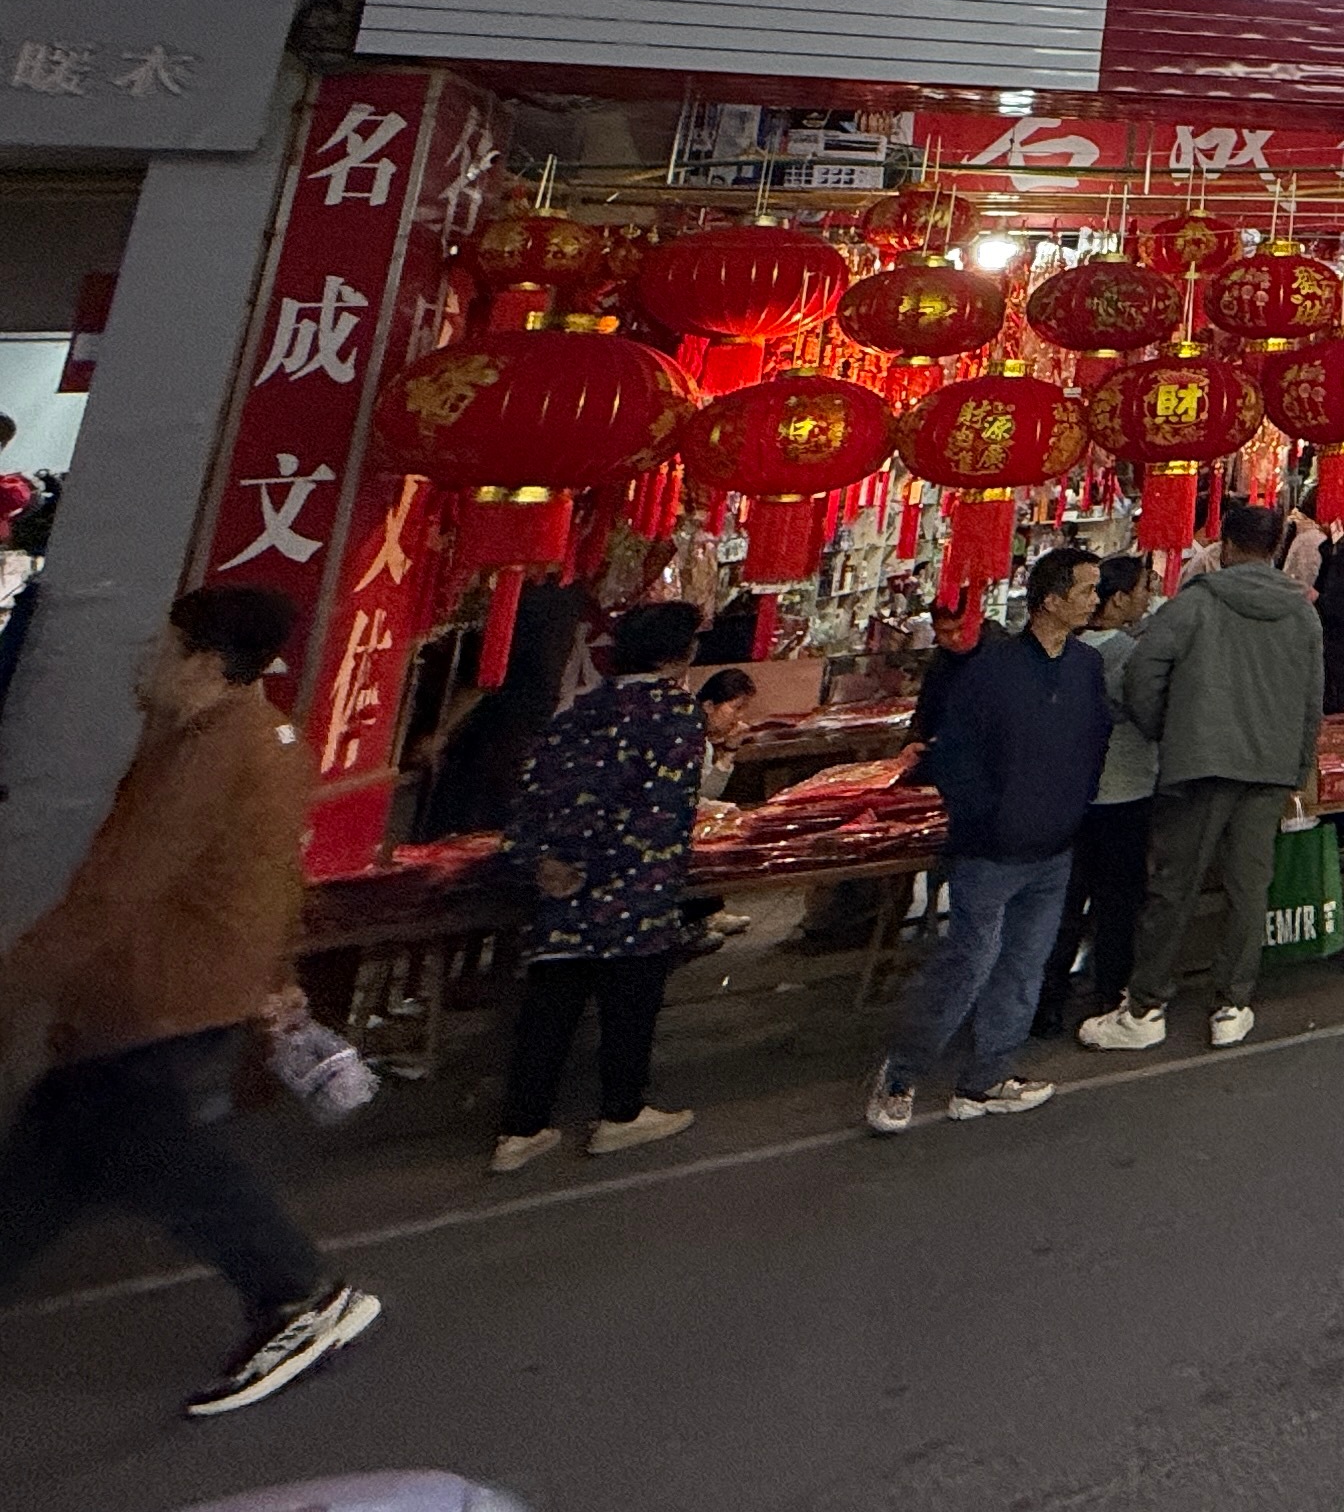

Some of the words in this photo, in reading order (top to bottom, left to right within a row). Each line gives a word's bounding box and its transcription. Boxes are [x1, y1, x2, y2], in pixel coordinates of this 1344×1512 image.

[218, 103, 408, 675] 名成文
[1156, 382, 1203, 424] 財
[1262, 905, 1317, 946] EMIR
